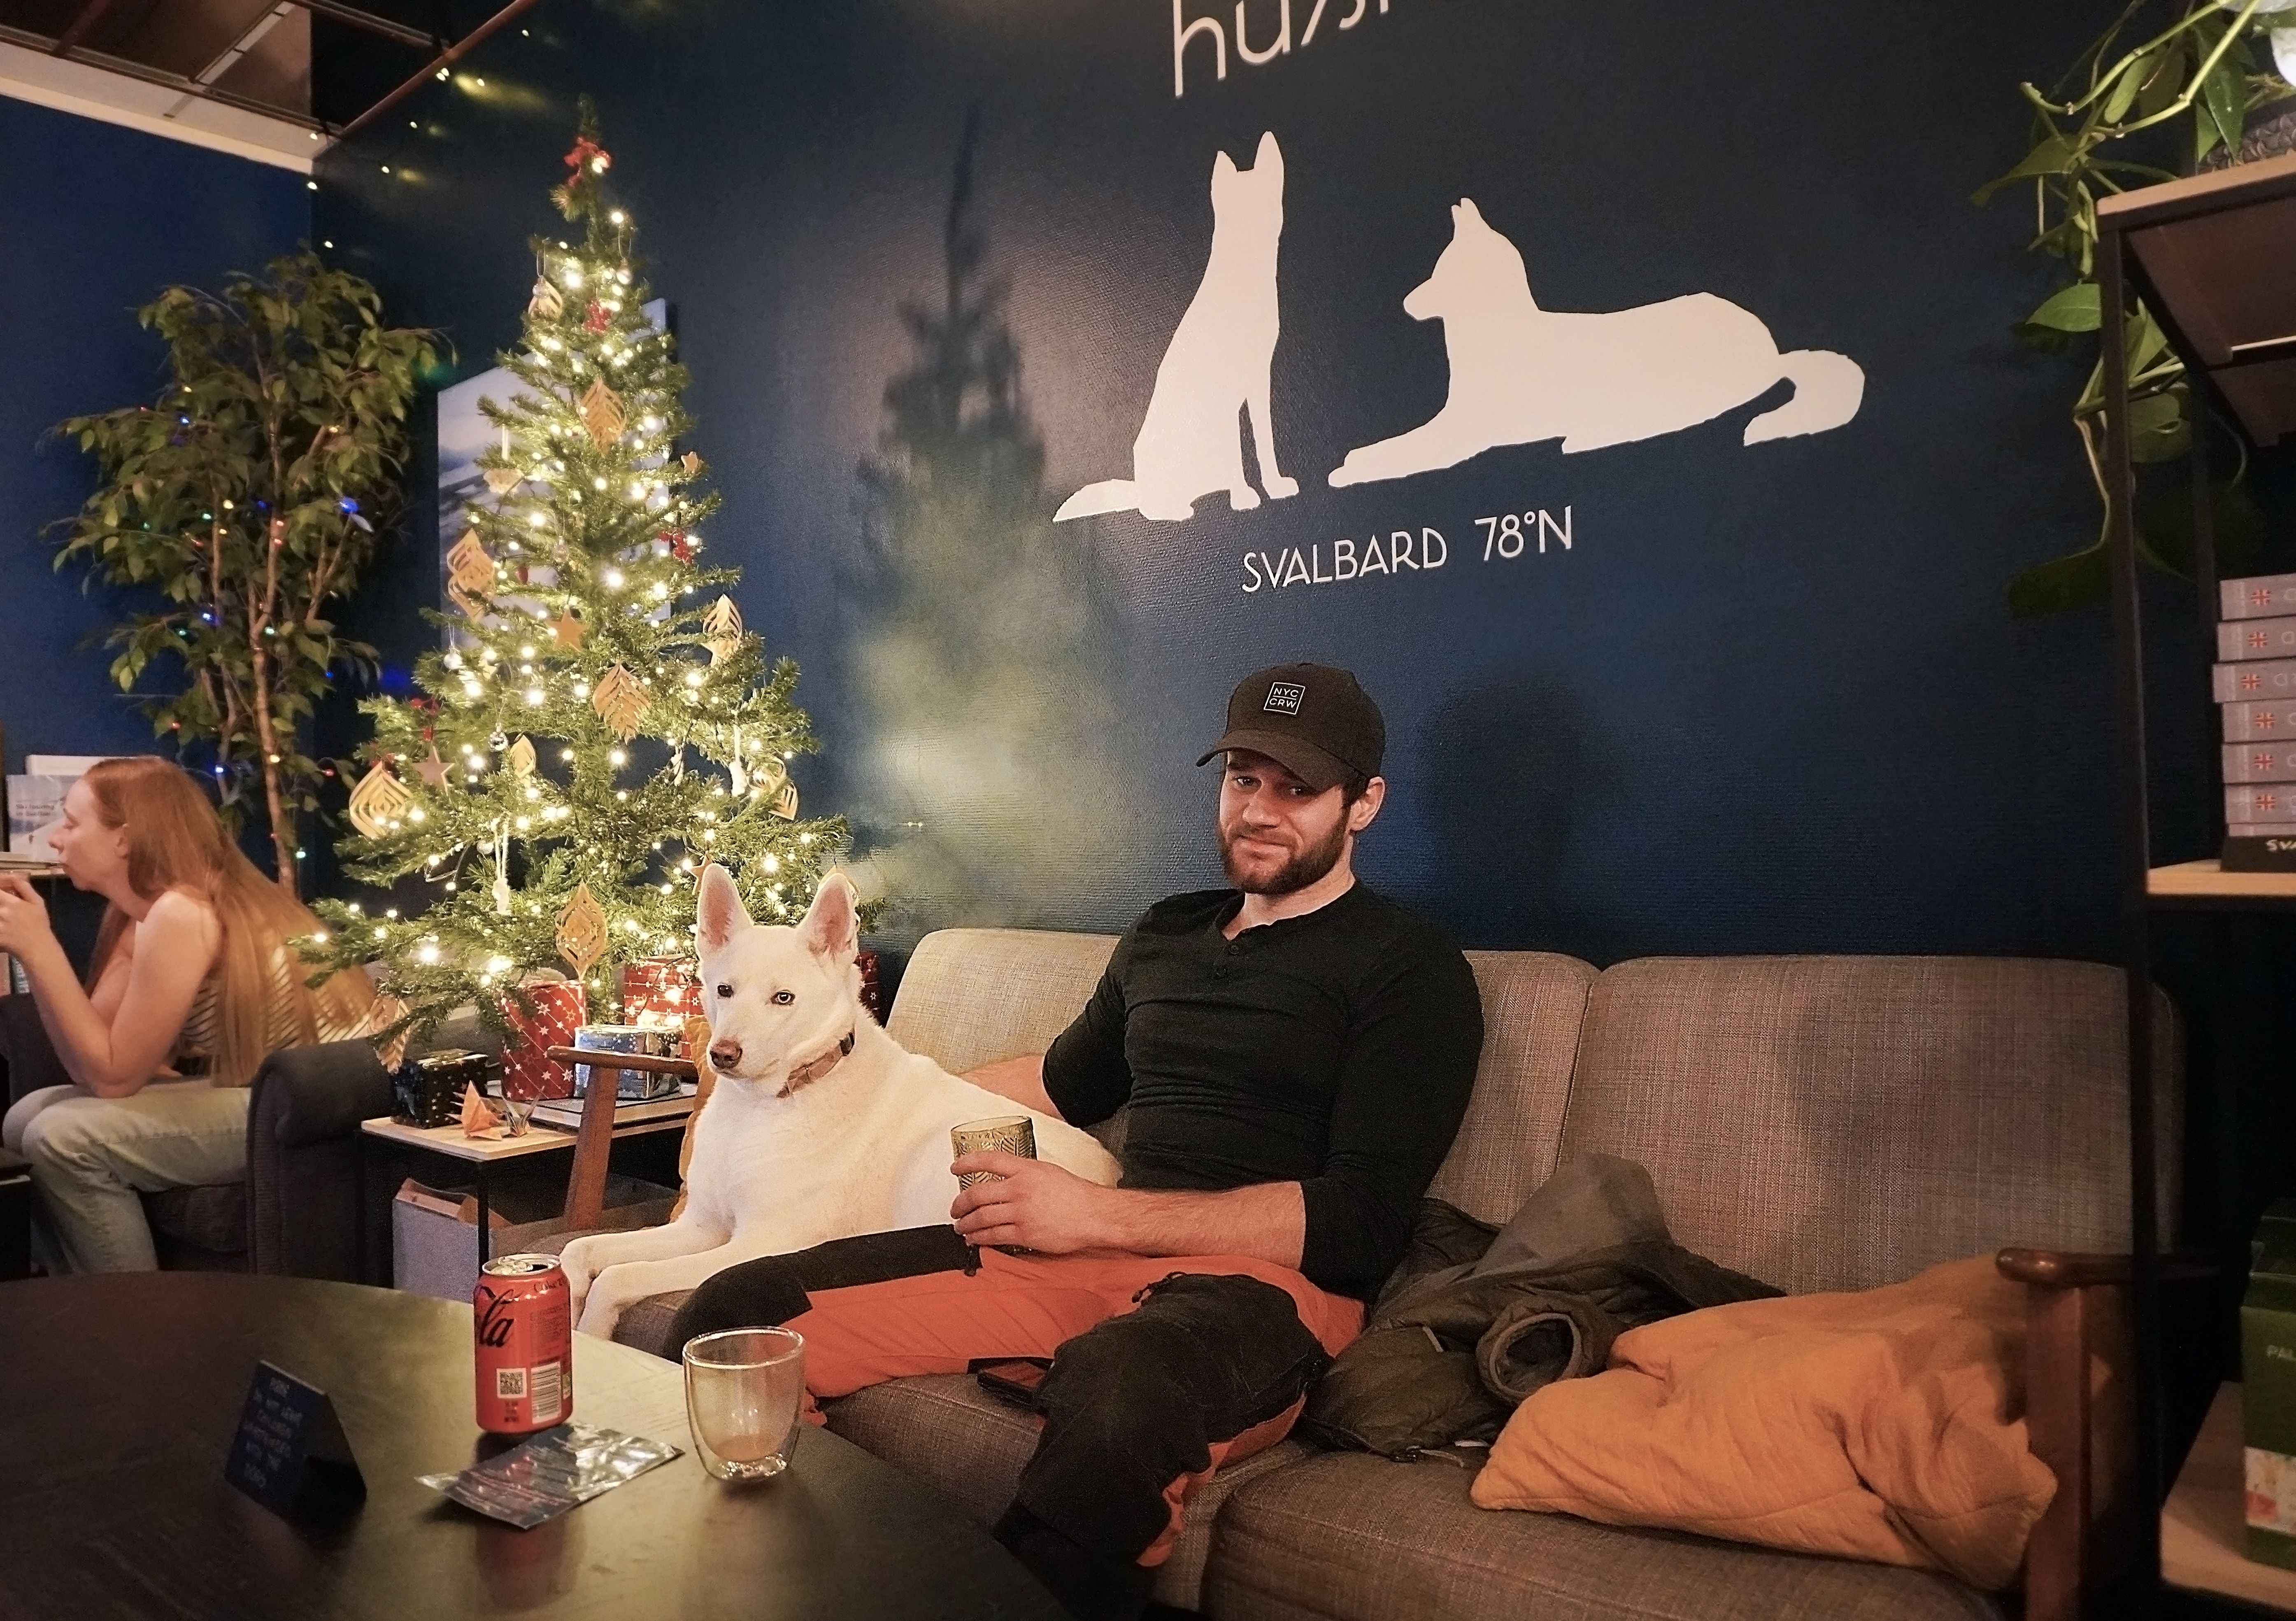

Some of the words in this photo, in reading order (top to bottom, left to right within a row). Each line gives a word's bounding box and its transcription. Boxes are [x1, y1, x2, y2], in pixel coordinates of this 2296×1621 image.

[1242, 527, 1447, 592] SVALBARD
[1474, 505, 1572, 561] 78°N
[1274, 687, 1299, 697] NYC
[1269, 698, 1296, 708] CRW
